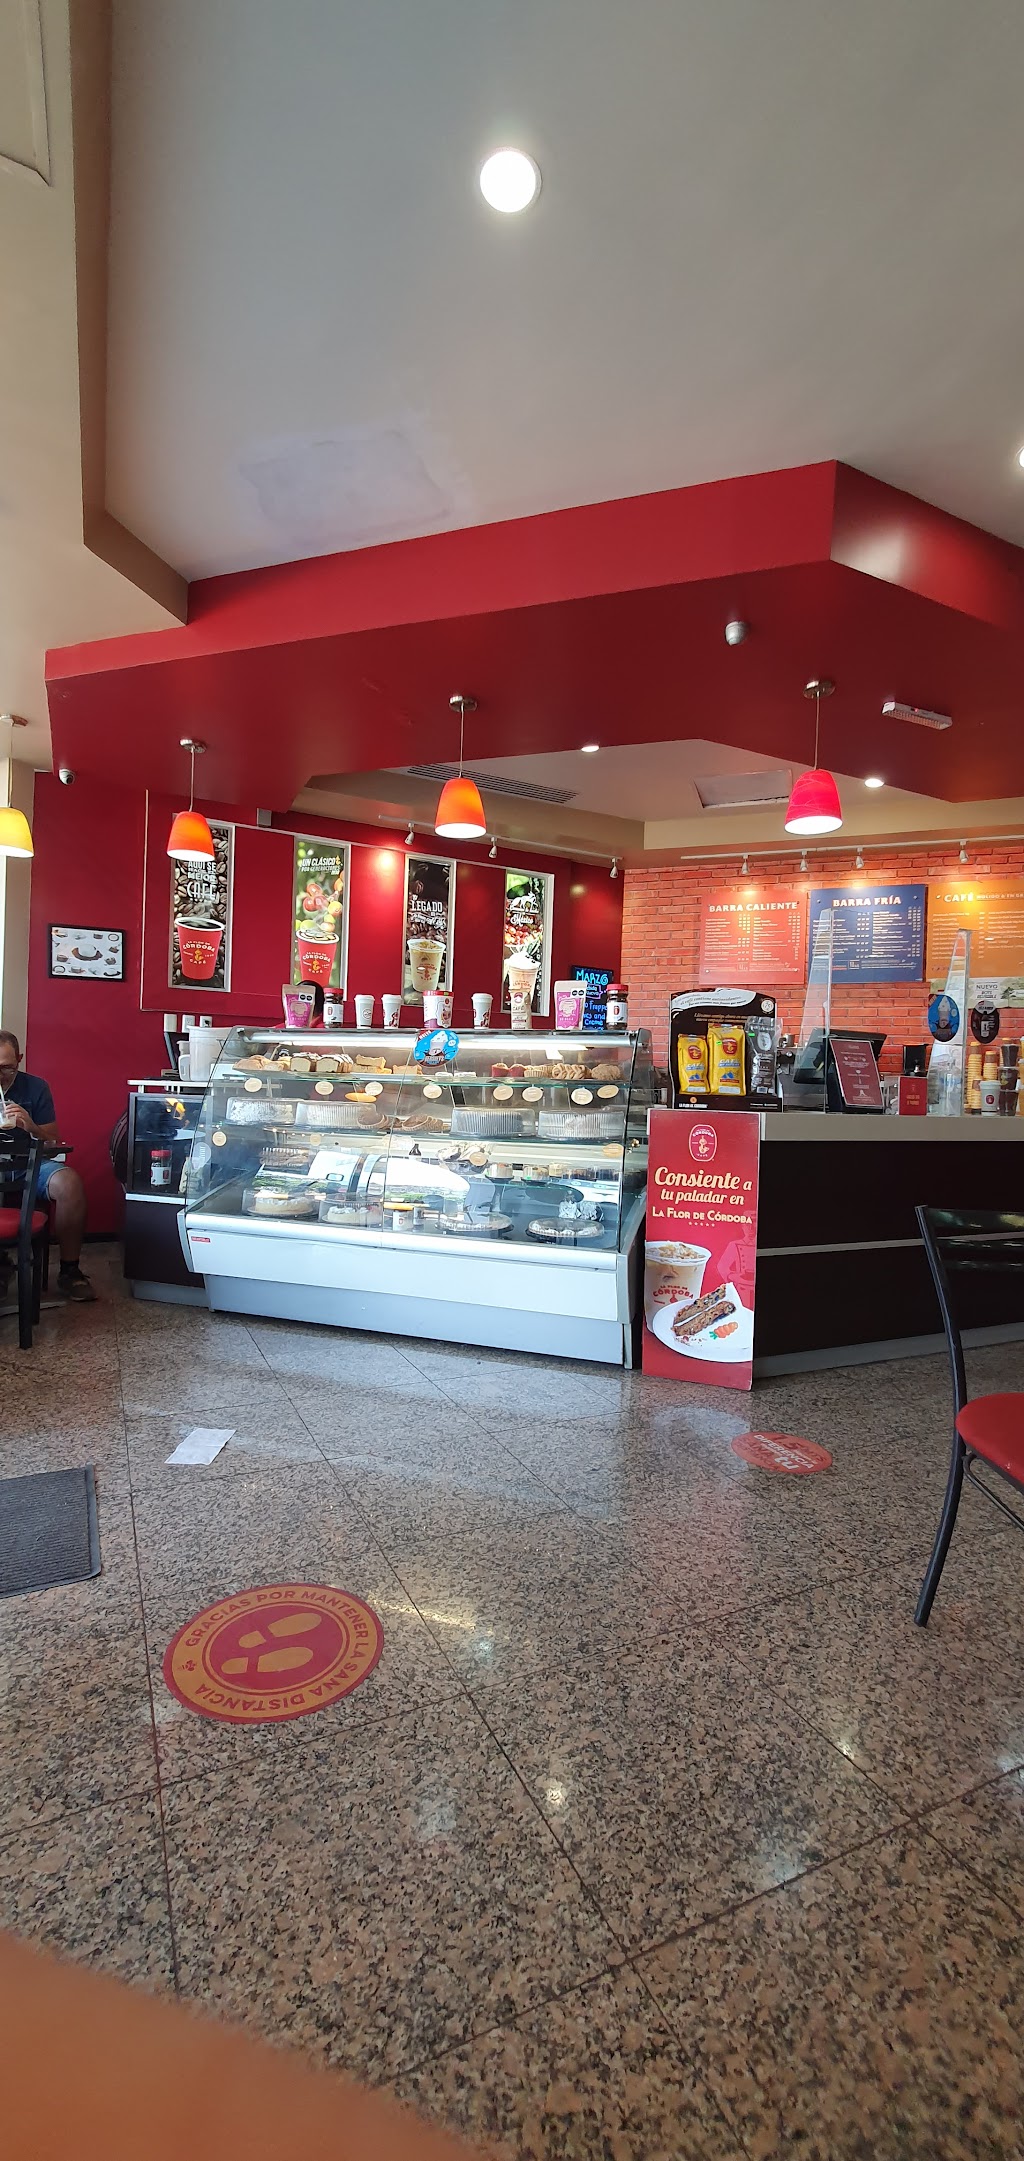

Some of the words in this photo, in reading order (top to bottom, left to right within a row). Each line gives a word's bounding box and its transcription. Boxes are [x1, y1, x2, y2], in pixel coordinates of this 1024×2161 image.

[311, 856, 336, 867] CLÁSICO
[832, 898, 871, 907] BARRA
[874, 895, 901, 905] FRÍA
[944, 892, 974, 903] CAFÉ
[411, 900, 443, 913] LEGADO
[708, 904, 744, 913] BARRA
[746, 901, 798, 912] CALIENTE
[182, 943, 215, 953] CÓRDOBA
[654, 1166, 740, 1190] Consiente
[742, 1180, 752, 1191] a
[660, 1188, 674, 1200] tu
[675, 1189, 728, 1204] paladar
[730, 1194, 744, 1206] en
[652, 1206, 664, 1218] LA
[666, 1207, 691, 1220] FLOR
[693, 1212, 704, 1220] DE
[706, 1210, 752, 1224] CÓRDOBA
[653, 1288, 694, 1299] CÓRDOBA
[753, 1434, 814, 1469] DIFERENCIA
[774, 1456, 800, 1470] tu
[256, 1590, 296, 1603] POR
[301, 1591, 369, 1639] MANTENER
[185, 1598, 251, 1648] GRACIAS
[352, 1642, 369, 1658] LA
[308, 1661, 358, 1697] SANA
[194, 1683, 306, 1712] DISTANCIA
